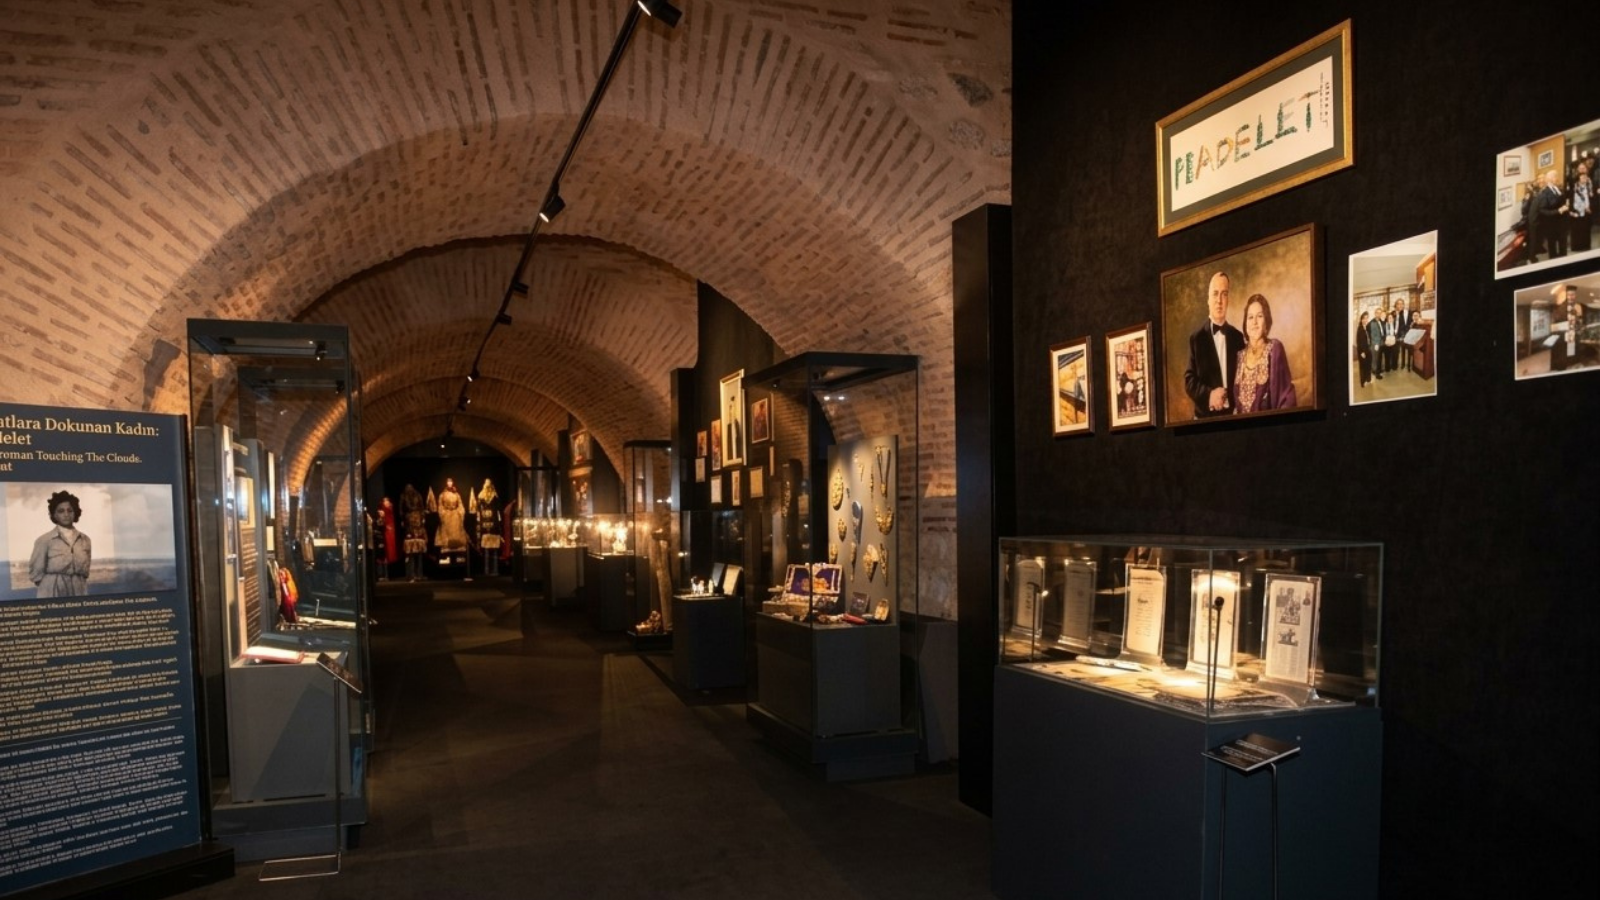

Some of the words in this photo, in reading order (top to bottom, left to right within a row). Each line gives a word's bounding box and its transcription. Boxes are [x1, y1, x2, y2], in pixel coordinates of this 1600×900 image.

[45, 417, 112, 434] Dokunan
[115, 422, 159, 436] Kadın:
[35, 450, 83, 464] Touching
[85, 452, 104, 462] The
